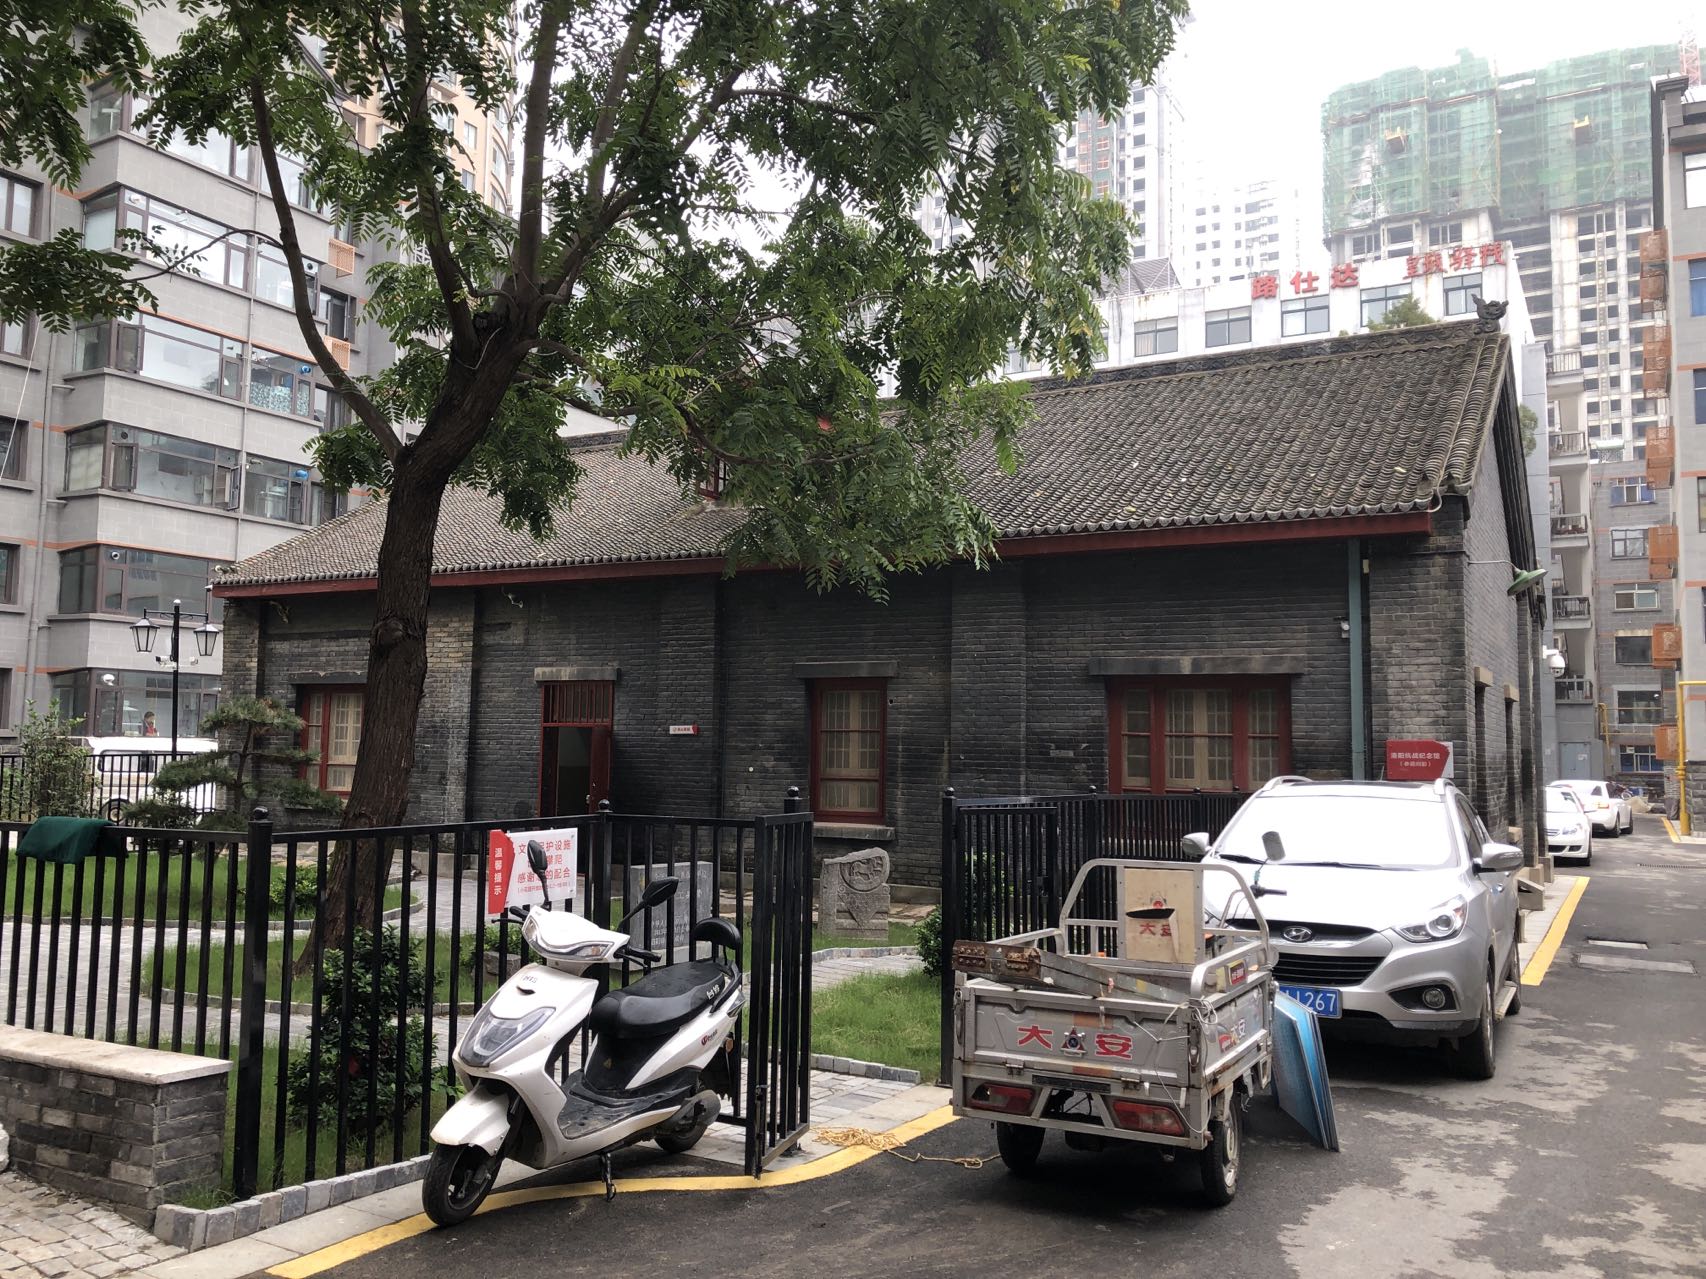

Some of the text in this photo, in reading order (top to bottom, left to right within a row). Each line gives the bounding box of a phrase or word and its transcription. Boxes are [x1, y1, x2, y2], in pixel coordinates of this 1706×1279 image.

[518, 839, 572, 855] 文护设施
[494, 847, 503, 896] 温馨提示
[517, 867, 571, 884] 感谢的配合
